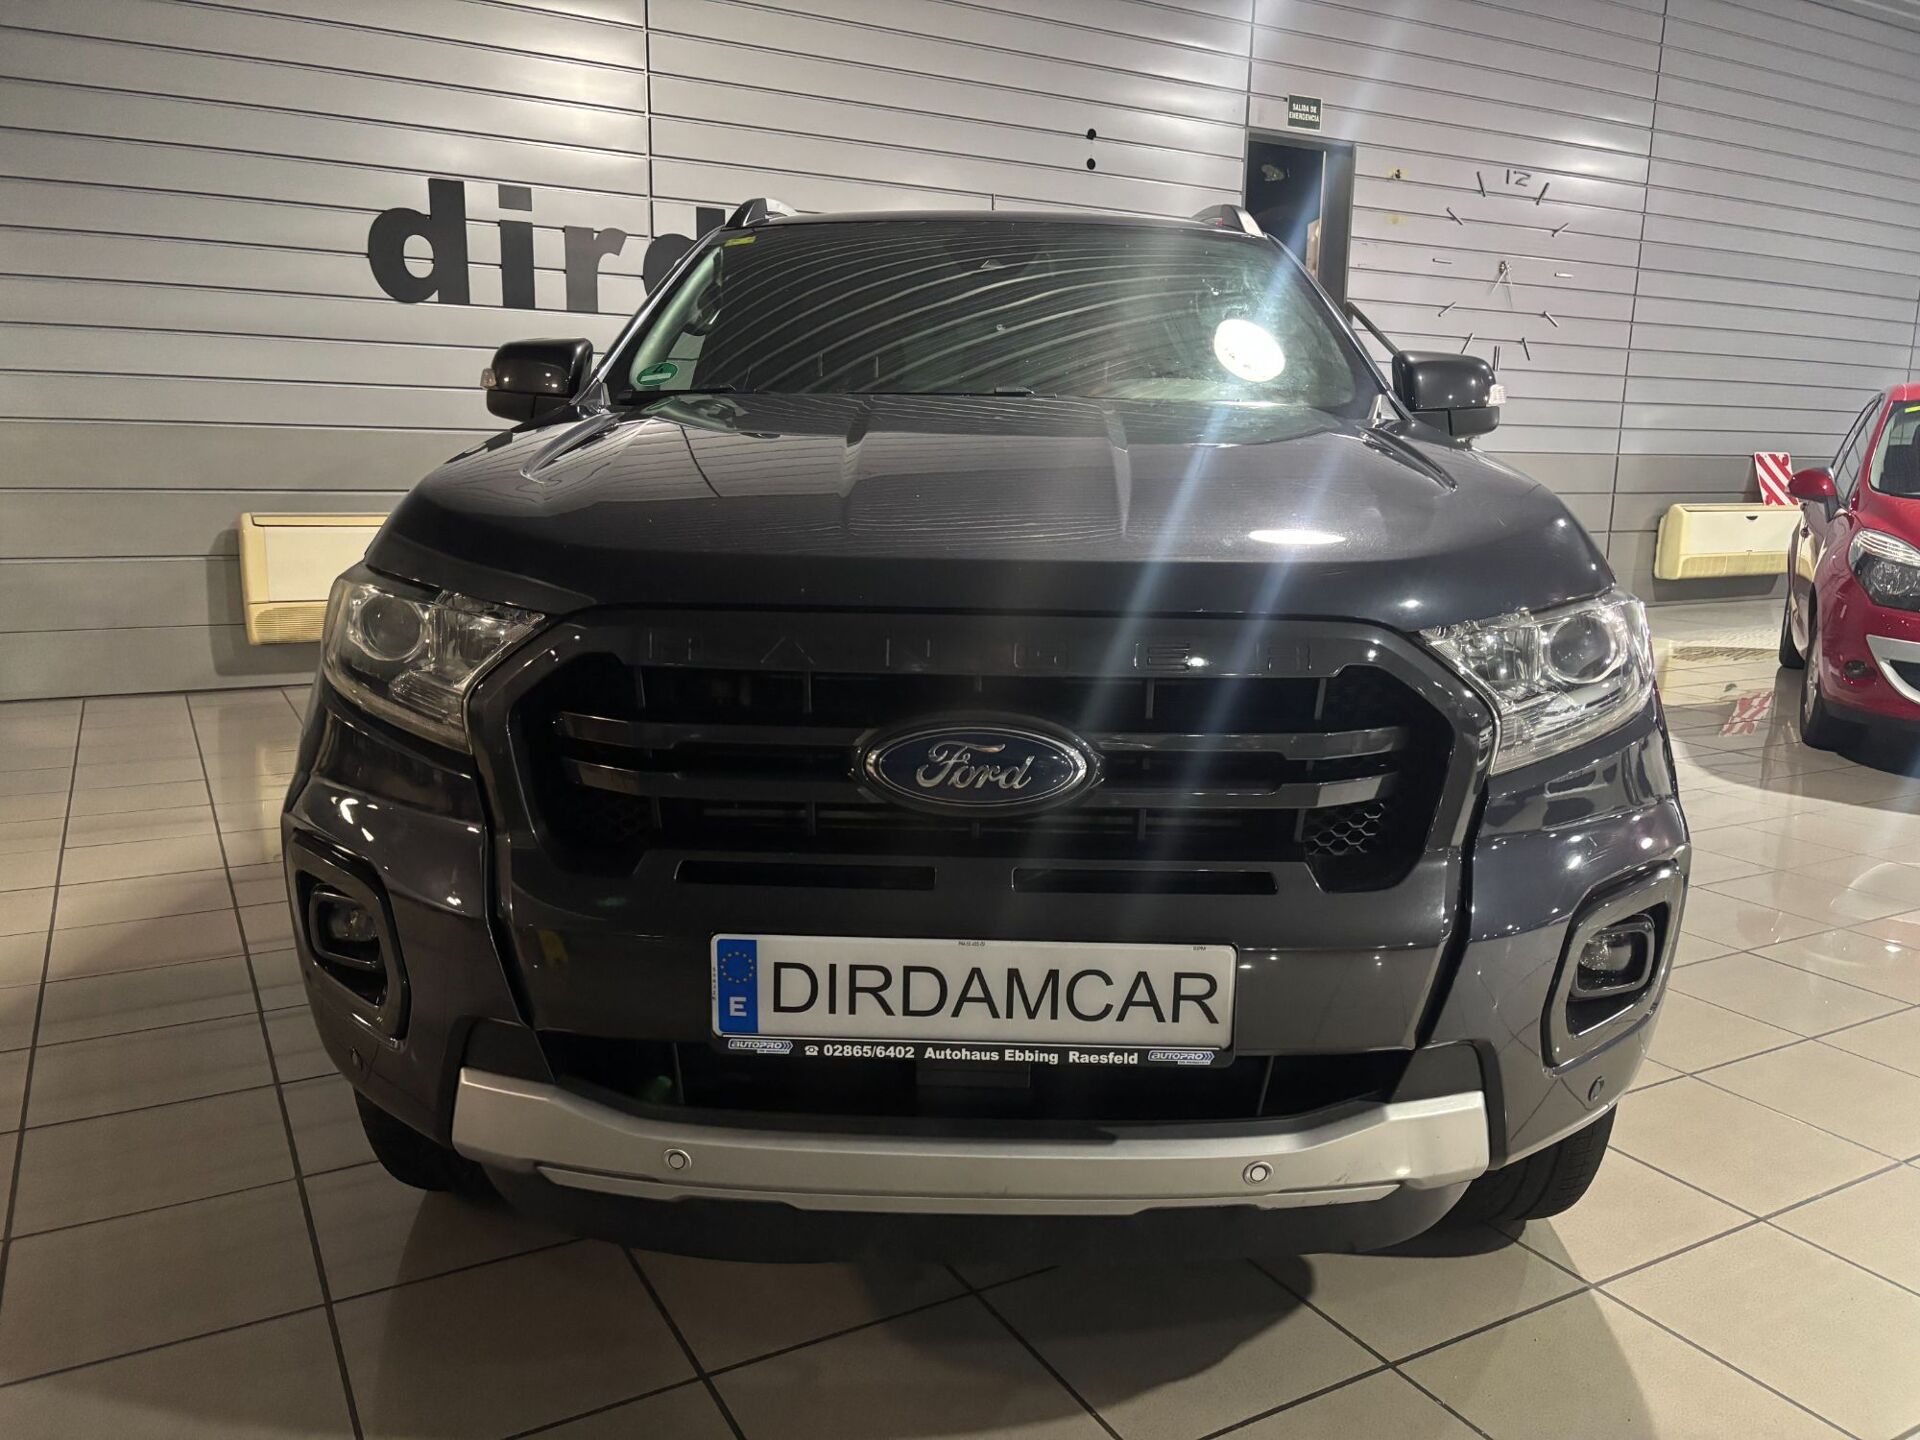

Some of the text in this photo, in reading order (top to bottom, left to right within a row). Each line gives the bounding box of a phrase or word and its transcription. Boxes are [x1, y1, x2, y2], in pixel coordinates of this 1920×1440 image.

[1289, 112, 1319, 122] EMERGENCIA
[1292, 103, 1309, 112] SALIDA
[1506, 169, 1531, 187] 12
[915, 740, 1035, 789] Ford
[772, 961, 1220, 1024] DIRDAMCAR
[729, 996, 747, 1017] E
[823, 1044, 1138, 1065] 02865/6402 Autohaus Ebbing Raesfeld
